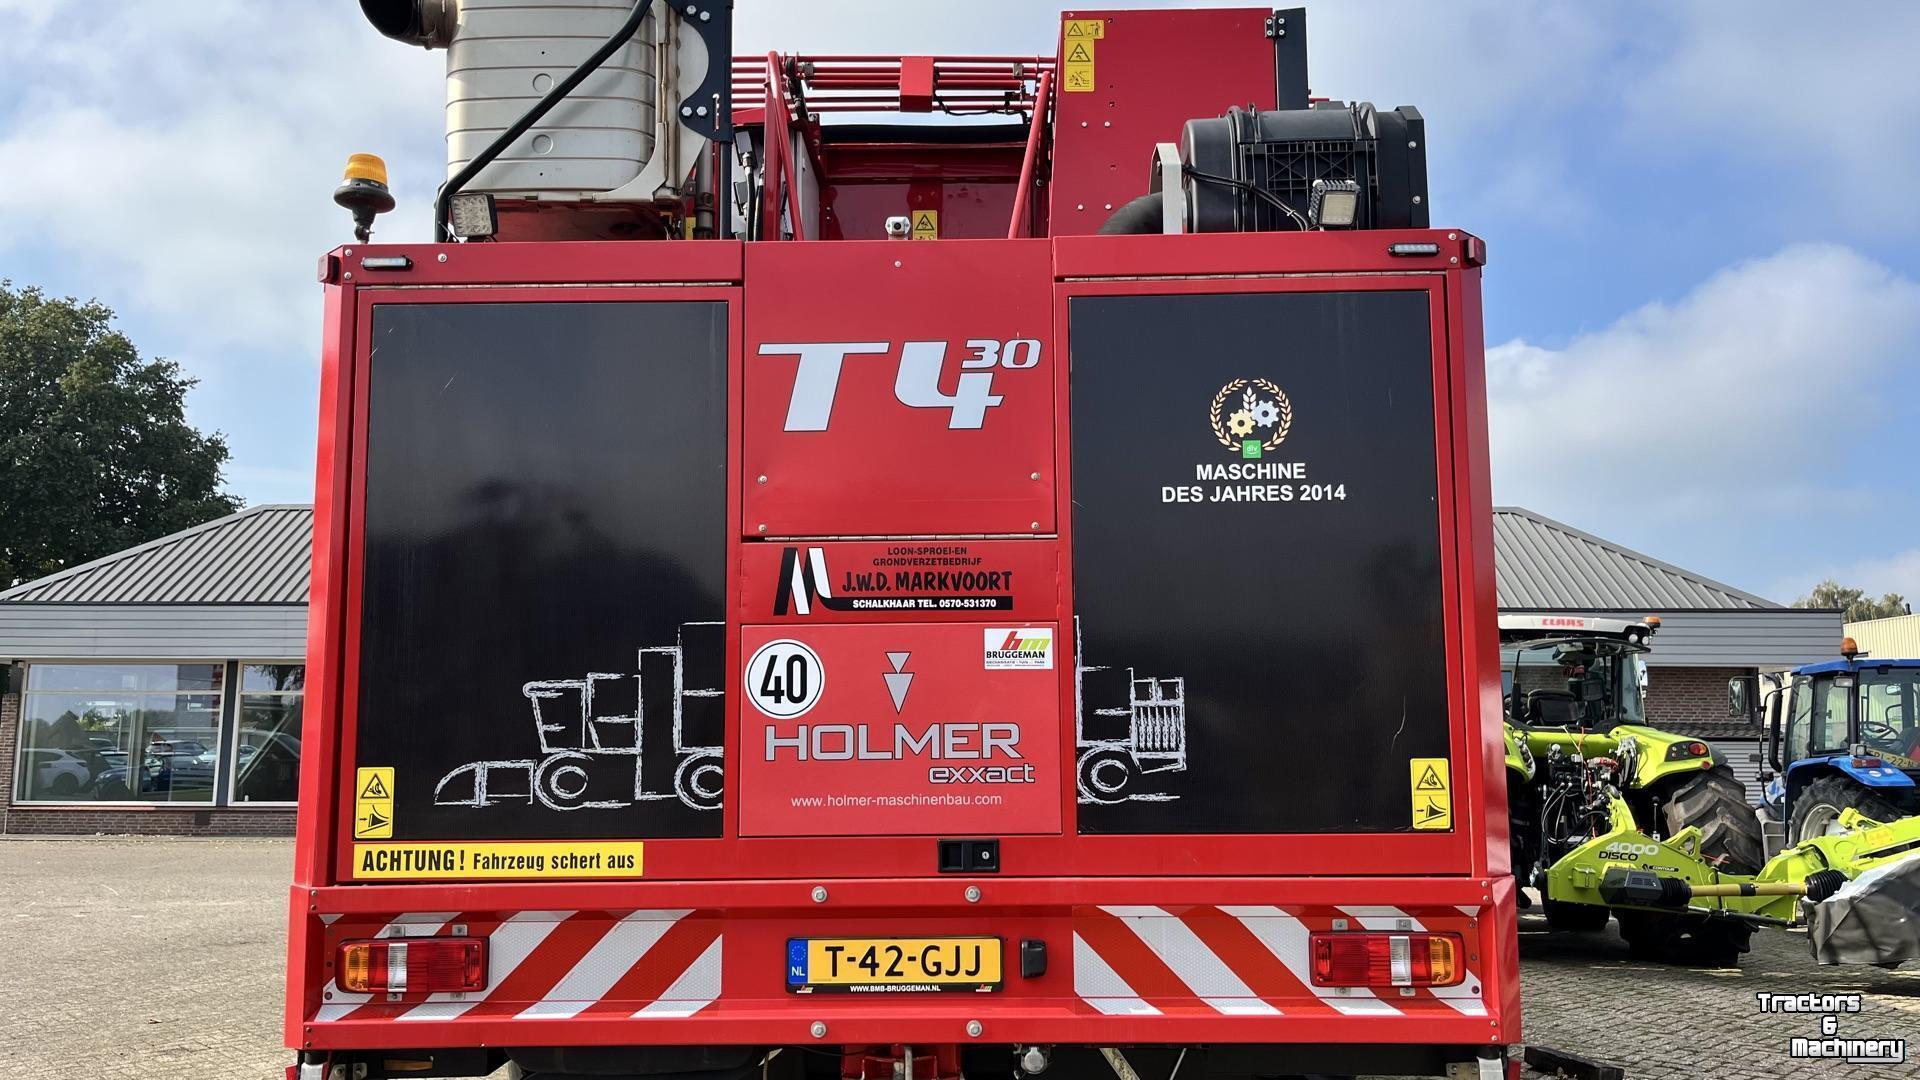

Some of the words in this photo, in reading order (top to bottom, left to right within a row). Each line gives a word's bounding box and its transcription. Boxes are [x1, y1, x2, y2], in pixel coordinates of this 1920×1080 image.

[1196, 463, 1306, 480] MASCHINE
[1162, 486, 1203, 502] DES
[1209, 485, 1293, 501] JAHRES
[1299, 484, 1346, 500] 2014
[873, 558, 982, 566] GRONDVERZETBEDRIJF
[842, 572, 891, 591] J.W.D.
[895, 571, 1012, 592] MARKVOORT
[852, 600, 916, 608] SCHALKHAAR
[918, 600, 937, 608] TEL.
[939, 599, 997, 608] 0570-531370
[1541, 618, 1585, 627] CLAAS
[760, 654, 808, 704] 40
[765, 723, 1024, 761] HOLMER
[928, 763, 1035, 784] exxact
[791, 793, 1002, 807] www.holmer-maschinenbau.com
[1599, 851, 1638, 861] DISCO
[1606, 842, 1659, 855] 4000
[473, 853, 545, 871] Fahrzeug
[551, 852, 601, 869] schert
[608, 854, 634, 869] aus
[825, 945, 981, 977] T-42-GJJ
[791, 966, 805, 976] NL
